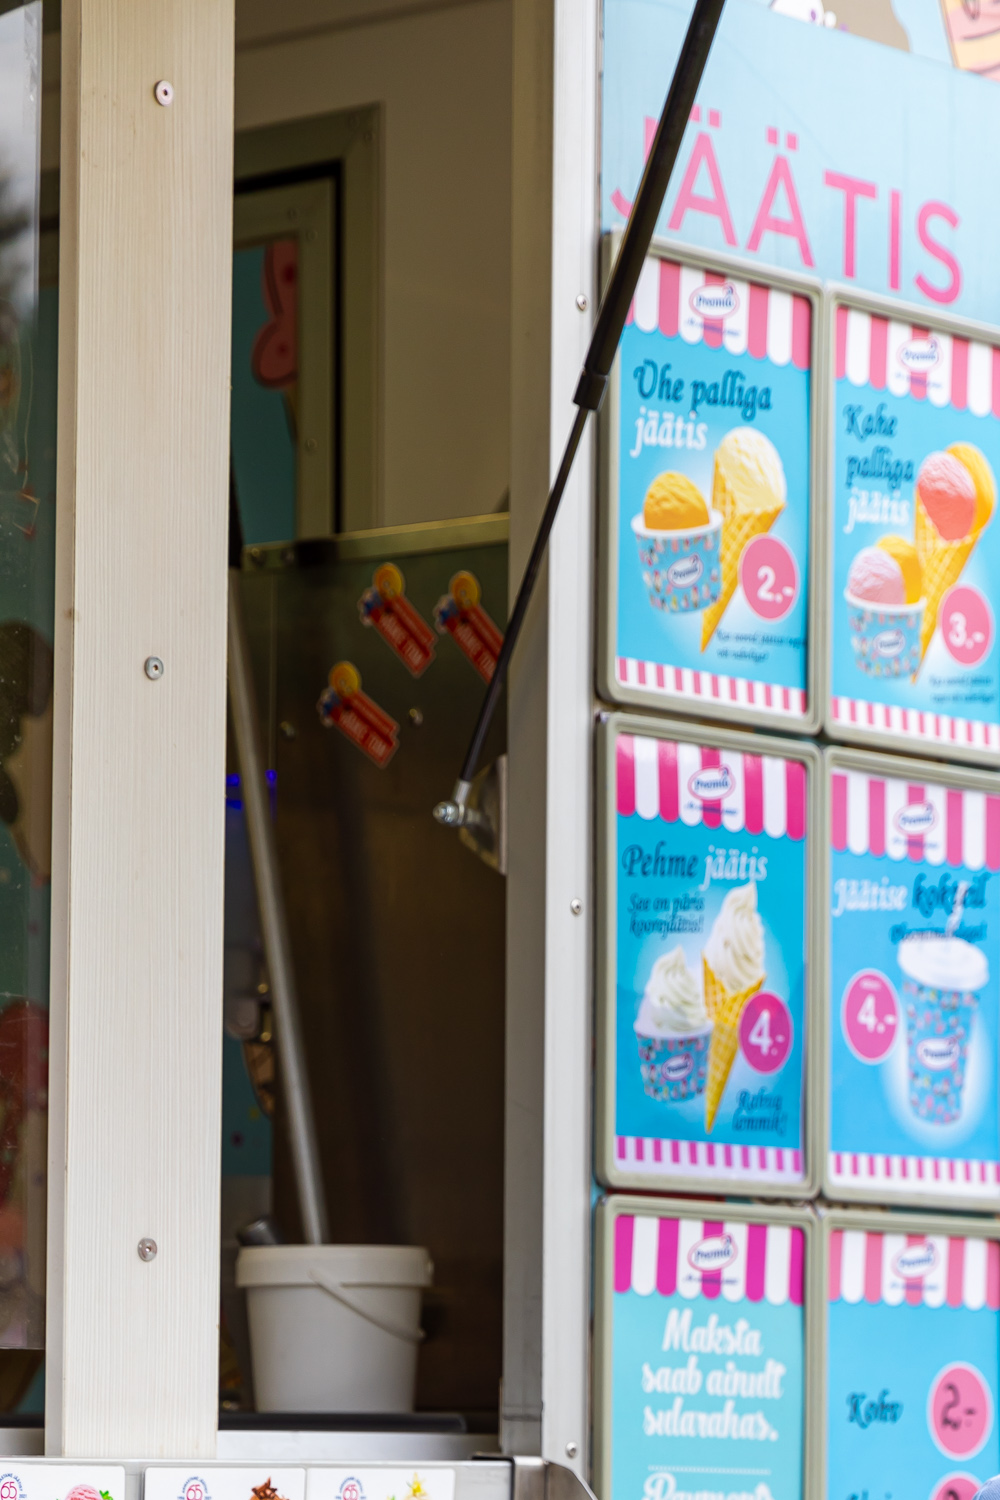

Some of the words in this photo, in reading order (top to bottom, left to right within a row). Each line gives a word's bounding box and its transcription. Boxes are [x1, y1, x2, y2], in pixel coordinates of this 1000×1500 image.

[689, 368, 773, 421] palliga
[629, 406, 709, 458] jäätis
[843, 402, 898, 442] Kahe
[845, 445, 914, 490] palliga
[843, 488, 911, 535] jäätis
[622, 840, 699, 878] Pehme
[699, 845, 768, 891] jäätis
[627, 892, 651, 913] See
[653, 897, 671, 912] on
[661, 1308, 763, 1356] Maksta
[641, 1354, 703, 1395] saab
[706, 1359, 786, 1399] ainult
[641, 1395, 779, 1442] sularahas.
